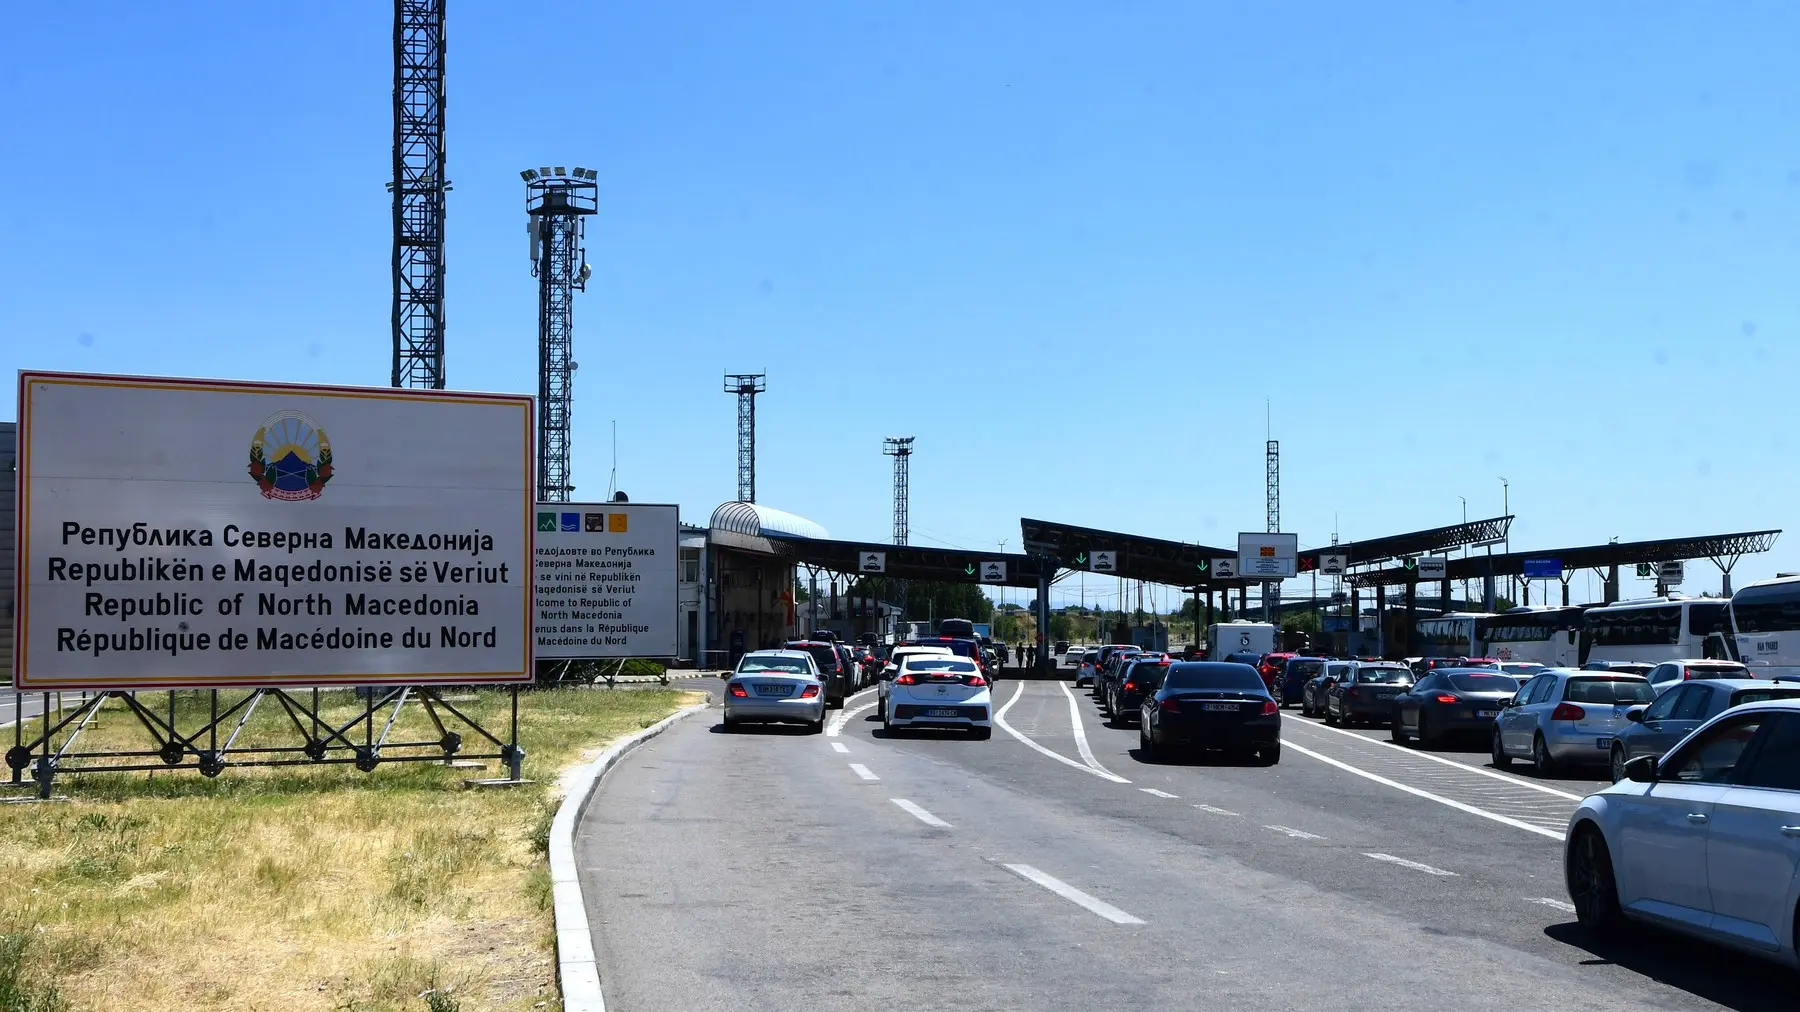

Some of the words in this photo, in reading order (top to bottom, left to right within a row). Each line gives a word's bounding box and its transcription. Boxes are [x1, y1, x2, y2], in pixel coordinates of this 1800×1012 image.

[62, 522, 213, 552] Република
[224, 524, 332, 554] Северна
[345, 527, 493, 556] Македонија
[536, 546, 587, 557] едојдовте
[605, 547, 654, 557] Република
[576, 559, 632, 570] Македонија
[48, 557, 203, 586] Republikën
[212, 564, 226, 581] e
[234, 559, 392, 587] Maqedonisë
[400, 561, 427, 583] së
[433, 561, 508, 583] Veriut
[555, 572, 572, 581] vini
[575, 572, 586, 581] në
[589, 572, 640, 583] Republikën
[535, 585, 587, 595] aqedonisë
[592, 585, 602, 593] së
[606, 585, 635, 593] Veriut
[85, 592, 203, 622] Republic
[218, 593, 244, 615] of
[259, 593, 331, 615] North
[346, 593, 478, 615] Macedonia
[536, 598, 565, 607] lcome
[568, 598, 577, 607] to
[580, 598, 620, 609] Republic
[623, 598, 632, 607] of
[541, 610, 568, 619] North
[572, 610, 622, 619] Macedonia
[560, 624, 582, 633] dans
[586, 624, 594, 632] la
[599, 624, 649, 635] République
[58, 627, 210, 657] République
[219, 628, 248, 650] de
[257, 627, 393, 650] Macédoine
[402, 626, 431, 648] du
[441, 626, 496, 648] Nord
[538, 637, 588, 645] Macédoine
[591, 636, 602, 645] du
[605, 636, 627, 645] Nord
